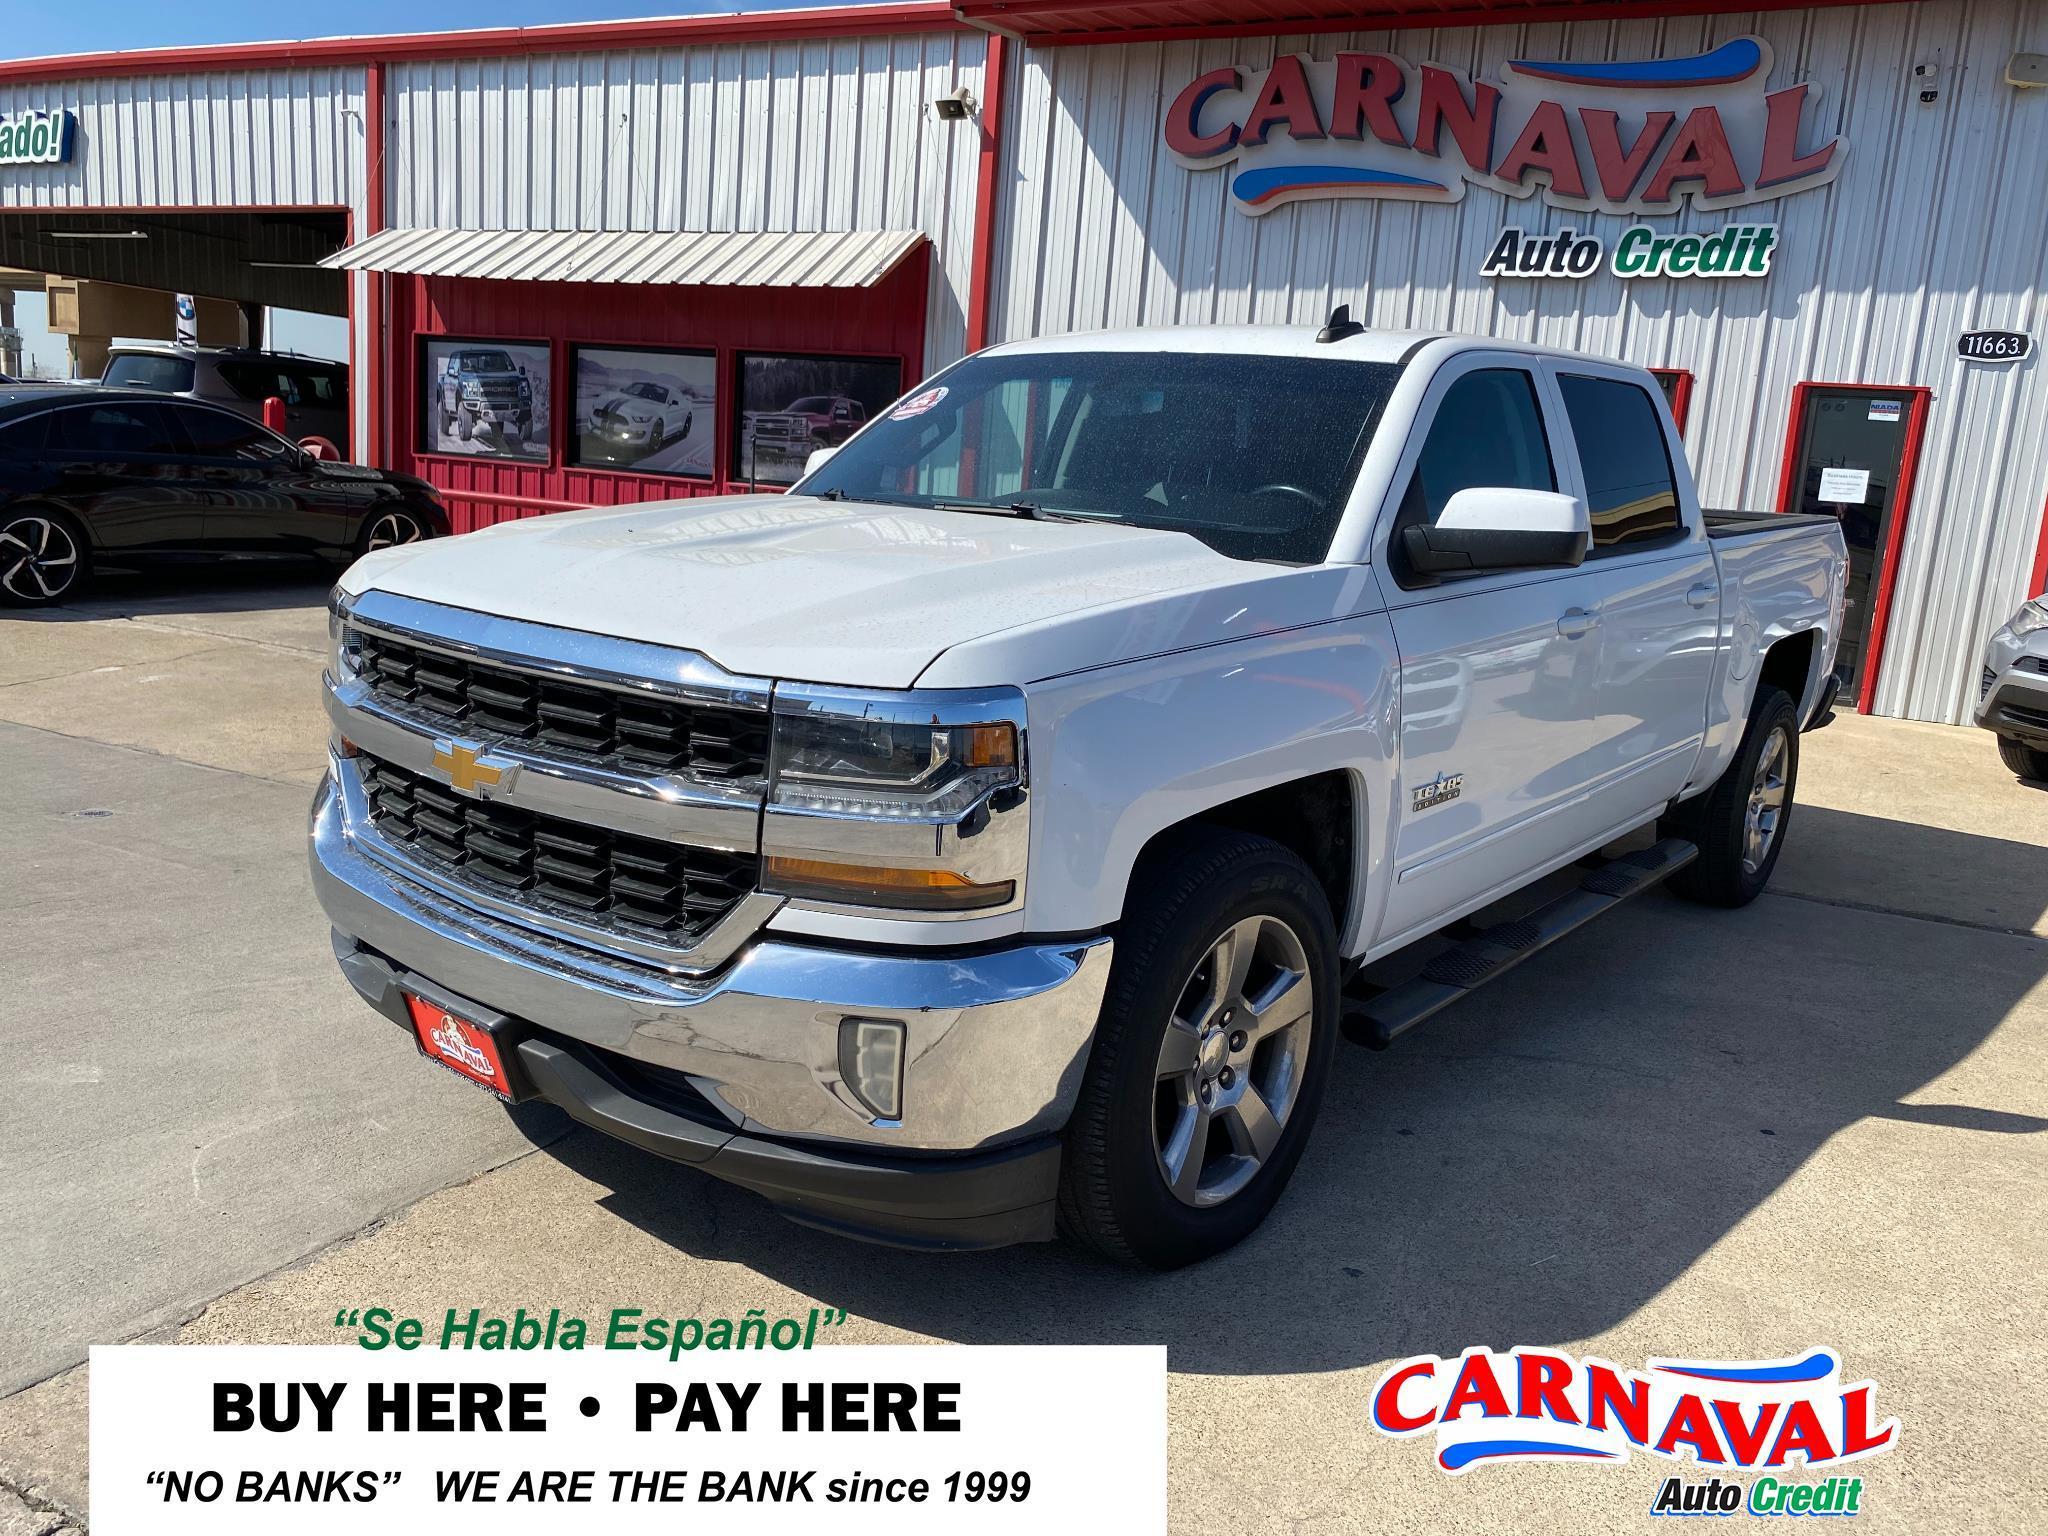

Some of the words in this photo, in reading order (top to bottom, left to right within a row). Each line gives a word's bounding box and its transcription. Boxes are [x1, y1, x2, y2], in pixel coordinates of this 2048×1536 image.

[0, 113, 60, 158] ado!
[1164, 52, 1840, 202] CARNAVAL
[1483, 228, 1601, 273] Auto
[1614, 226, 1775, 273] Credit
[1966, 335, 2021, 355] 11663
[1412, 776, 1464, 801] TEXAS
[431, 1028, 494, 1074] CARNAVAL
